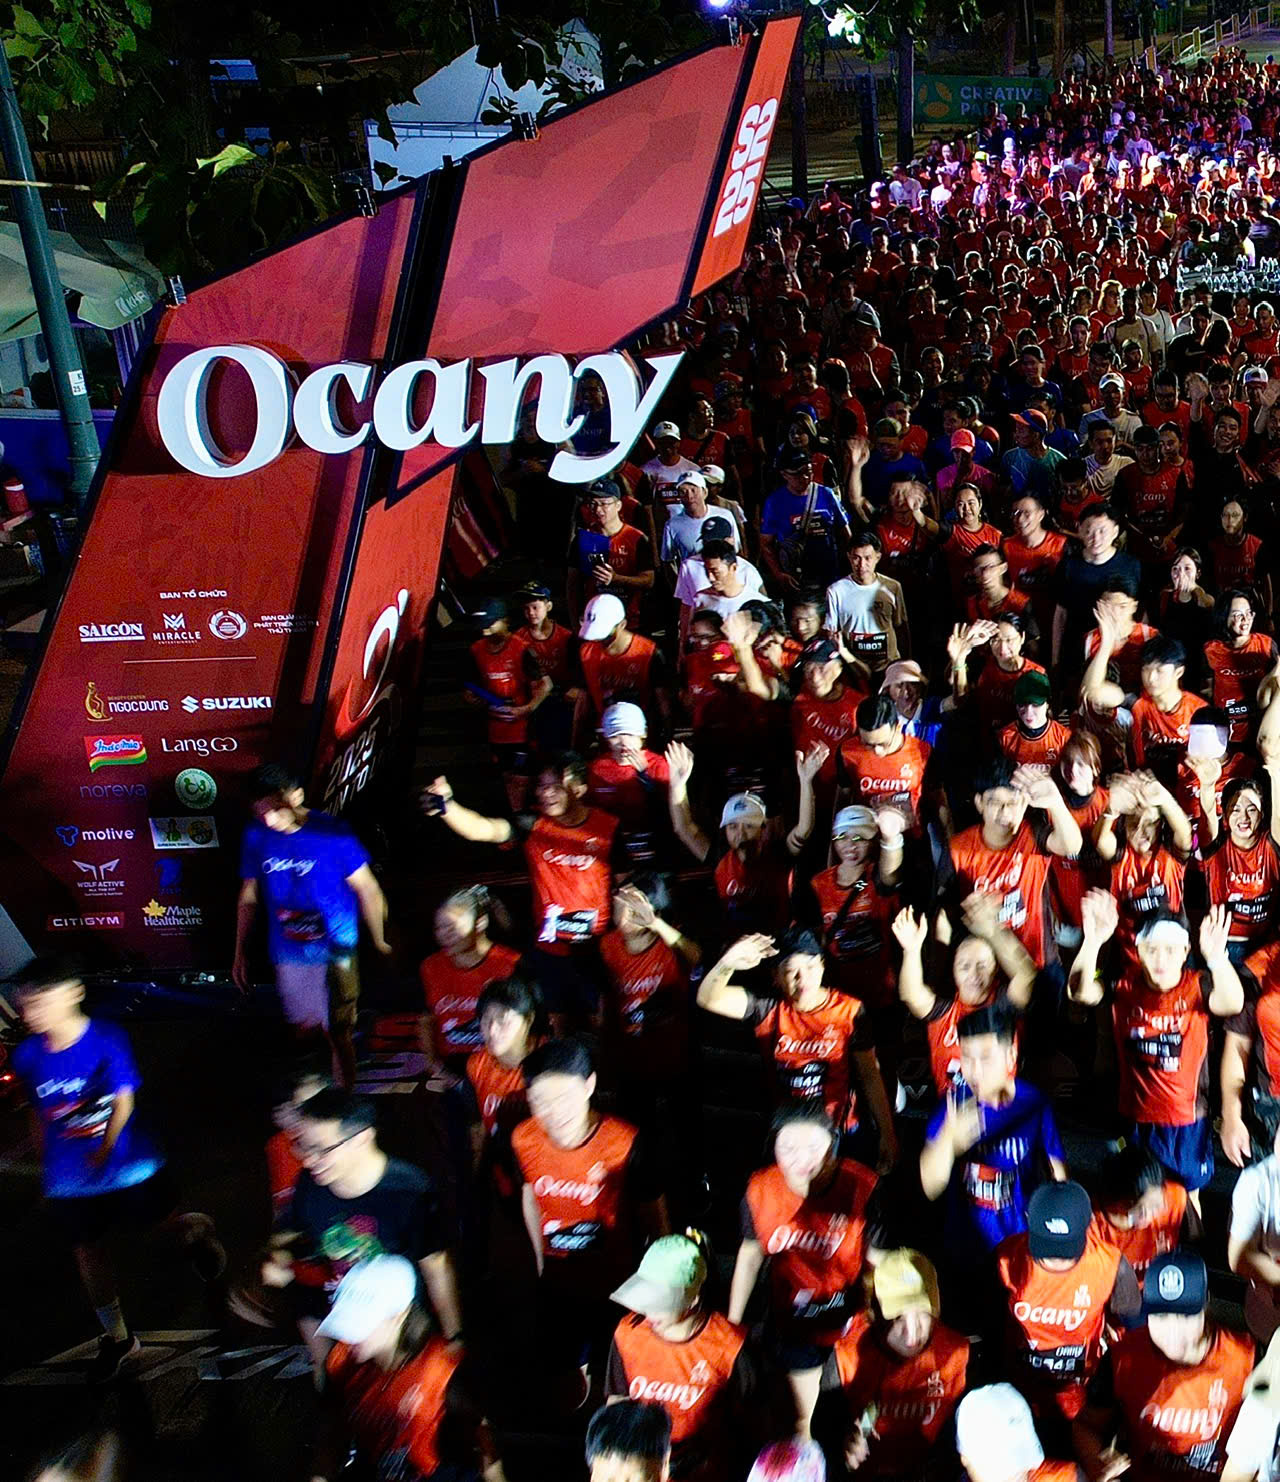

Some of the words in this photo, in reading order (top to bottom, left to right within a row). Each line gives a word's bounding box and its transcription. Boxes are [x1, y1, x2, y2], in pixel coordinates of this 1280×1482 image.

[157, 344, 686, 483] Ocany
[183, 589, 196, 599] TỐ
[79, 621, 144, 637] SÀIGÒN
[152, 631, 201, 641] MIRACLE
[202, 696, 272, 710] SUZUKI
[161, 738, 209, 757] Lang
[80, 783, 148, 799] noreva
[860, 777, 911, 793] Ocany
[82, 827, 135, 841] motive
[97, 880, 125, 888] ACTIVE
[166, 905, 201, 916] Maple
[53, 916, 120, 927] CITIGYM
[144, 916, 203, 926] Healthcare
[1013, 1300, 1088, 1332] Ocany
[628, 1374, 711, 1410] Ocany
